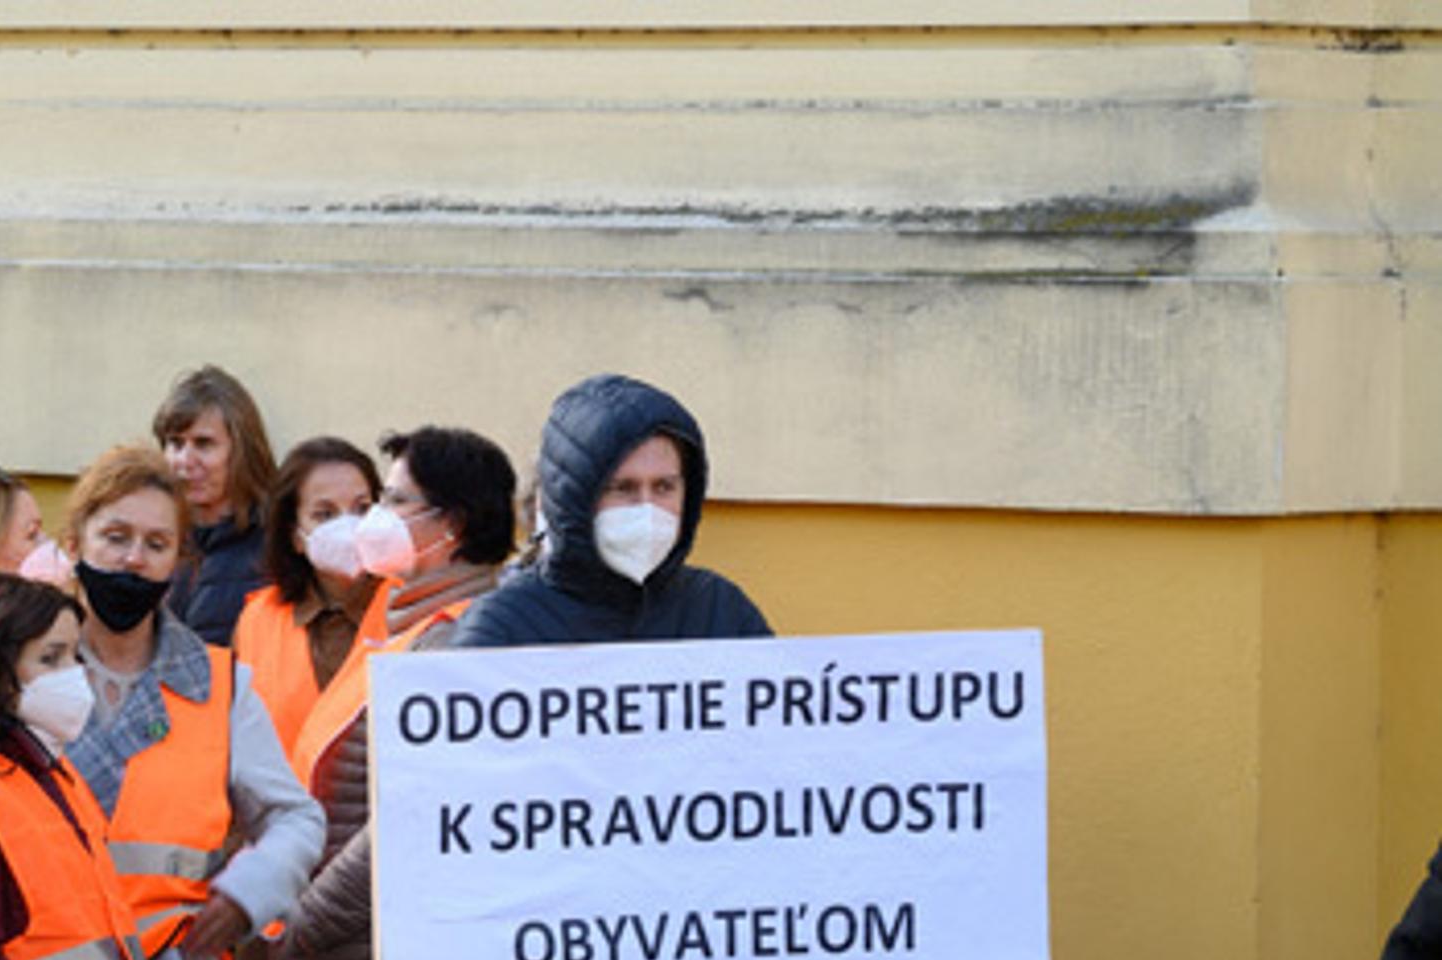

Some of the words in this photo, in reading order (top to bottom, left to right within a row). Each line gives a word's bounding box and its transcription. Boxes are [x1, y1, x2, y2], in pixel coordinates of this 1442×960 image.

[399, 680, 726, 745] ODOPRETIE
[747, 662, 1024, 727] PRÍSTUPU
[440, 803, 472, 854] K
[490, 782, 984, 852] SPRAVODLIVOSTI
